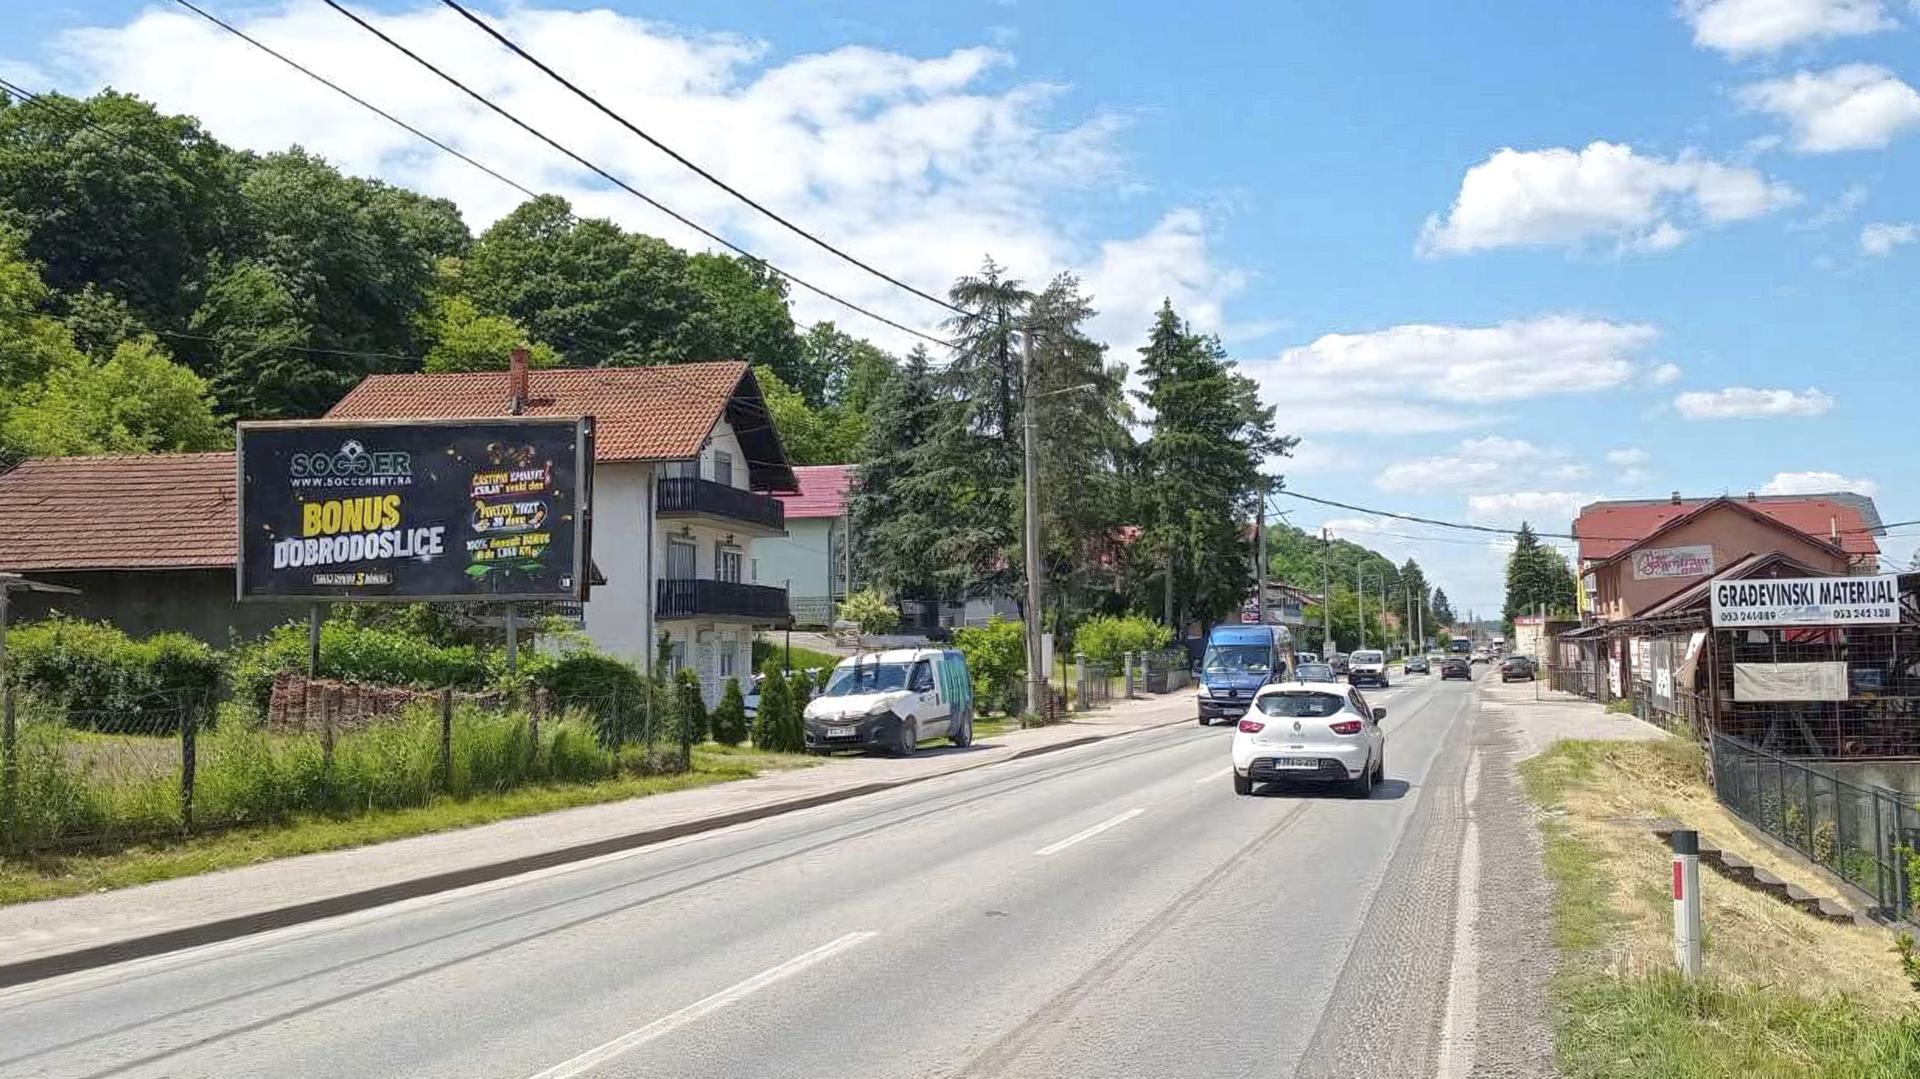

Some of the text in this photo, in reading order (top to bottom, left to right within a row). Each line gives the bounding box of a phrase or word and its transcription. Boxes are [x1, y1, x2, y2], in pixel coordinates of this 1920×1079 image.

[291, 452, 411, 476] SOCCER
[303, 494, 401, 538] BONUS
[273, 525, 445, 570] DOBRODOŠLICE
[1717, 580, 1895, 608] GRAĐEVINSKI MATERIJAL
